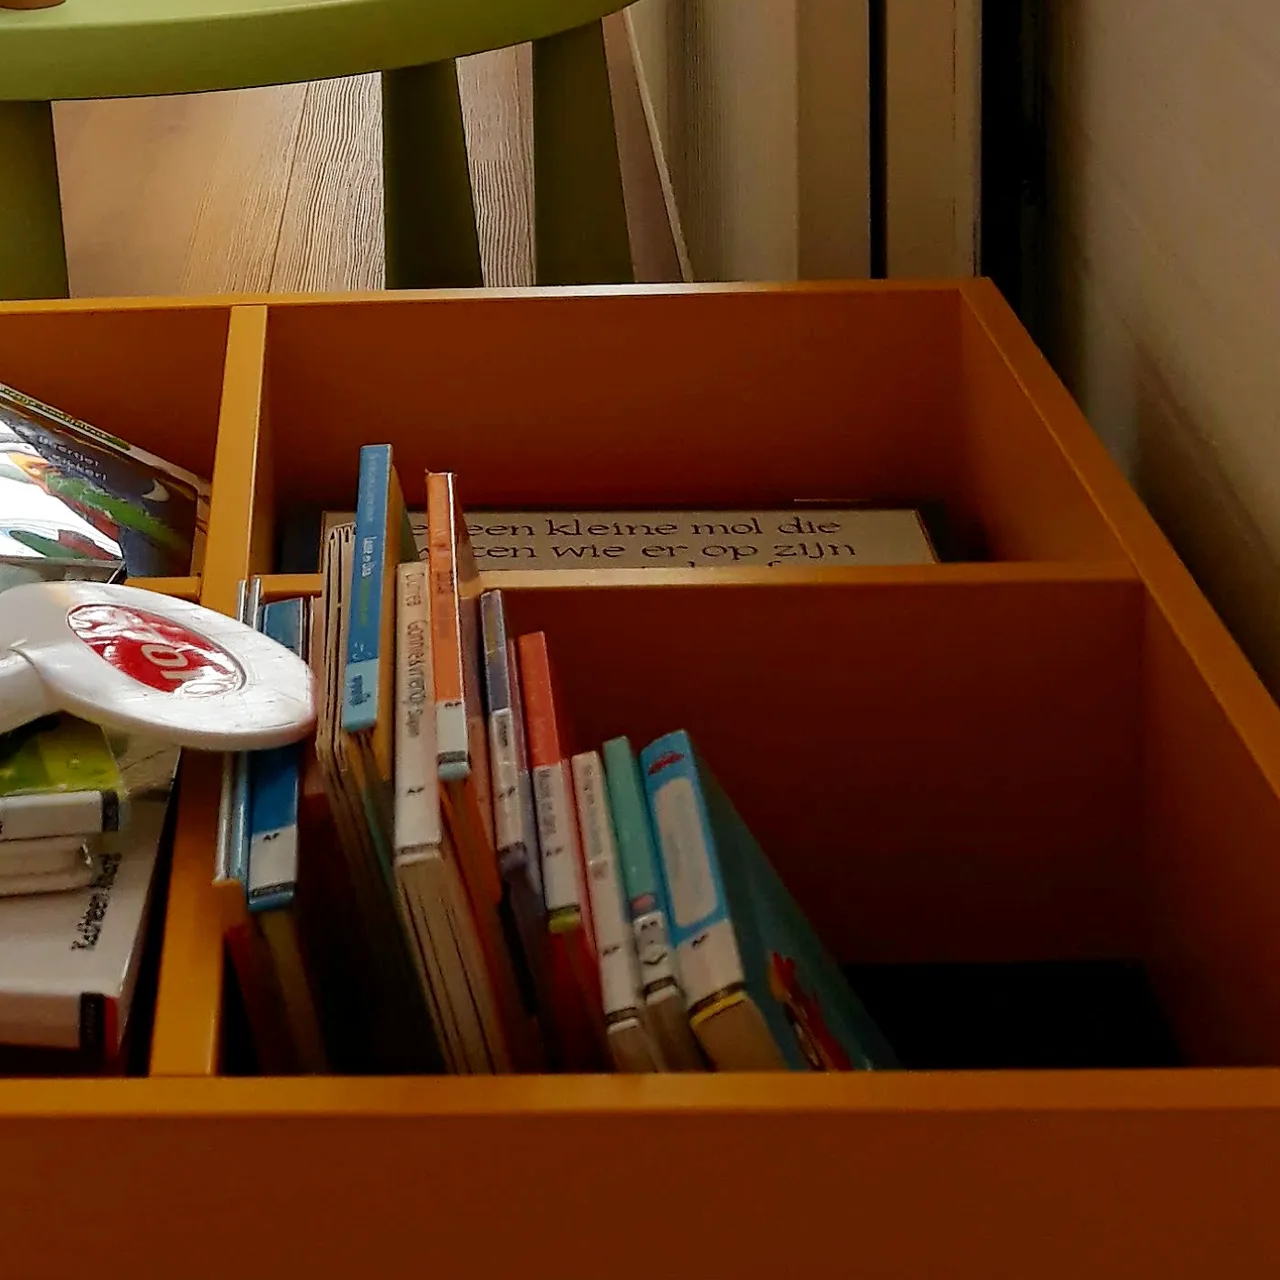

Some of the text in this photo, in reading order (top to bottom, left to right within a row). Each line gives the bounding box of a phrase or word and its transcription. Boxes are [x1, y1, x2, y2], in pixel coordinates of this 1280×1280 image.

[467, 516, 842, 537] een kleine mol die
[552, 544, 626, 558] wie
[641, 544, 688, 558] er
[701, 544, 759, 561] op
[773, 542, 857, 559] zijn
